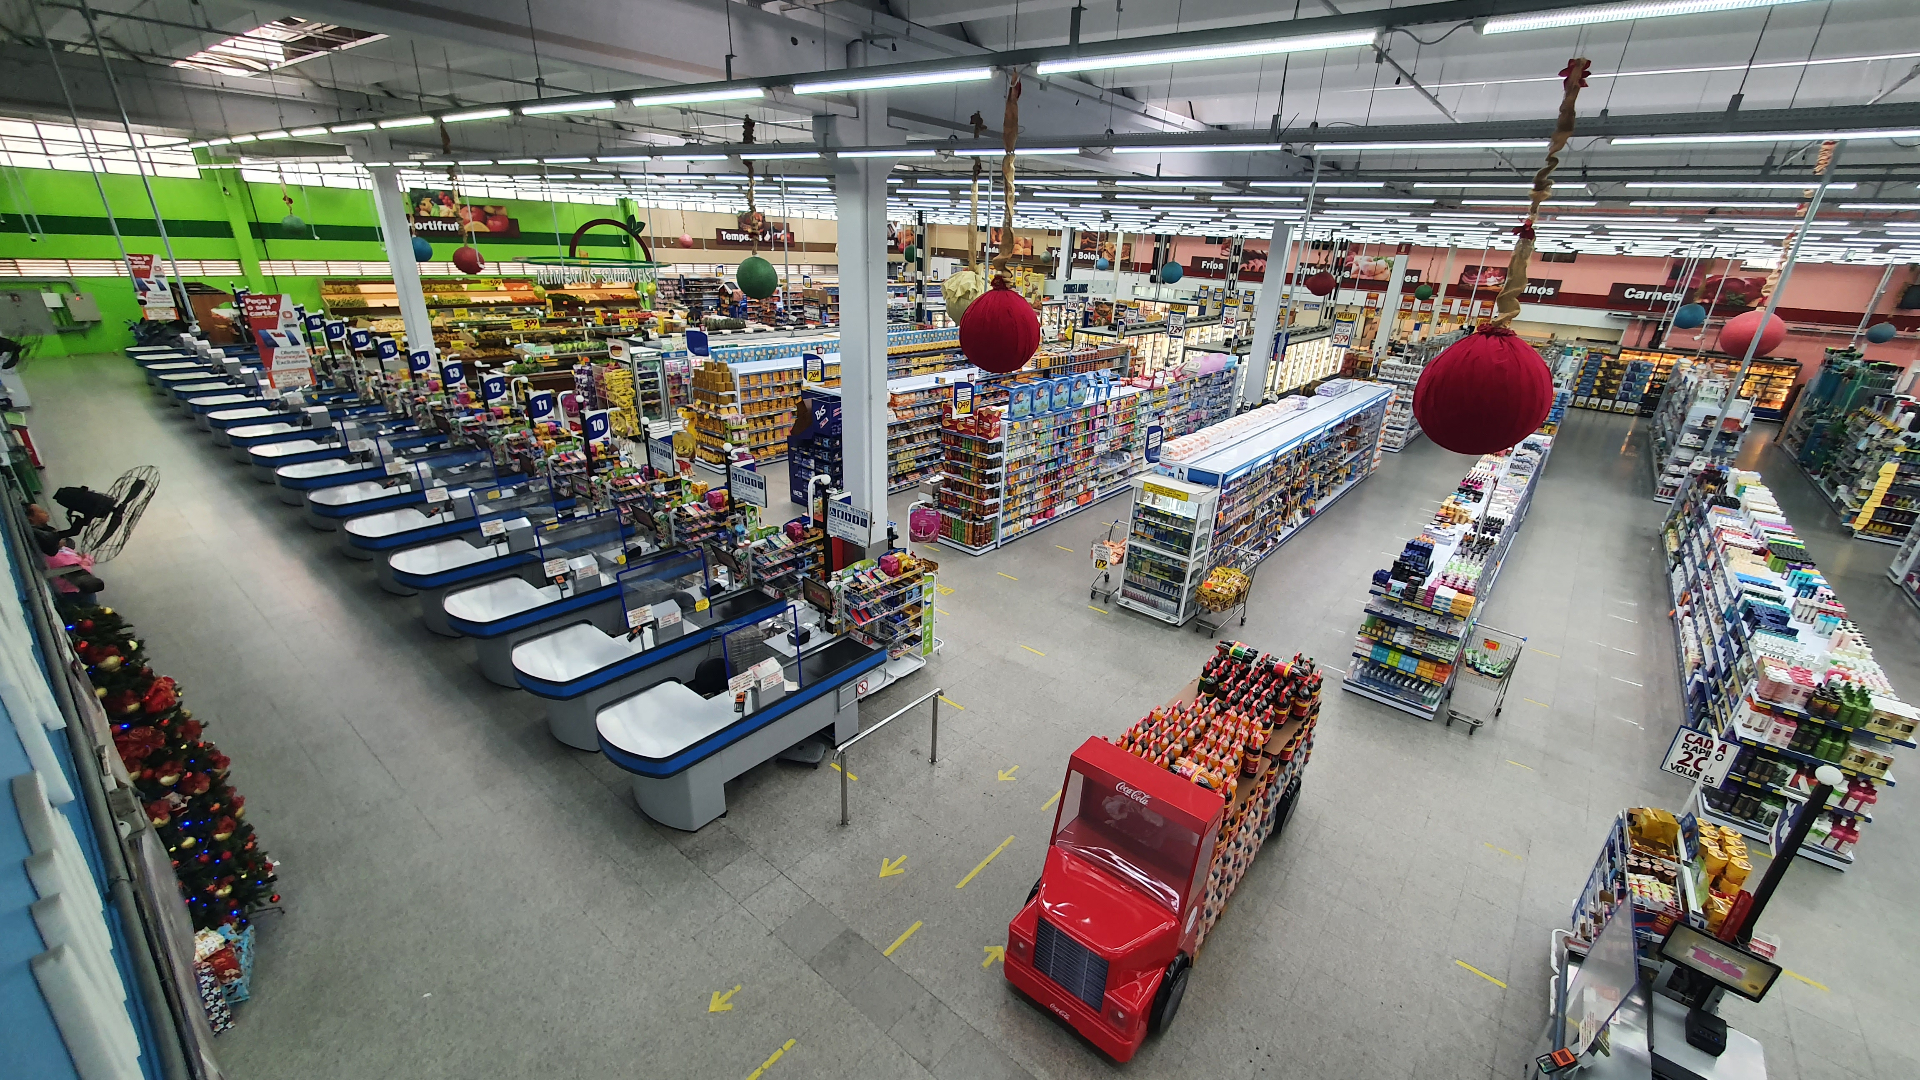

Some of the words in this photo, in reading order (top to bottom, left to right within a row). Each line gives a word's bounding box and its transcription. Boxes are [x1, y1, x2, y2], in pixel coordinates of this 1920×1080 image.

[407, 220, 460, 231] Hortifrut
[1201, 260, 1224, 270] Frios
[537, 269, 597, 285] ALIMENTOS
[1624, 288, 1684, 302] Carnes
[331, 325, 340, 334] 17
[1170, 325, 1183, 334] 229
[1333, 334, 1349, 343] 599
[383, 344, 394, 354] 15
[415, 356, 427, 365] 14
[448, 367, 460, 378] 13
[489, 382, 502, 393] 12
[536, 399, 548, 411] 11
[591, 419, 604, 432] 10
[1115, 781, 1152, 806] Coca-Cola
